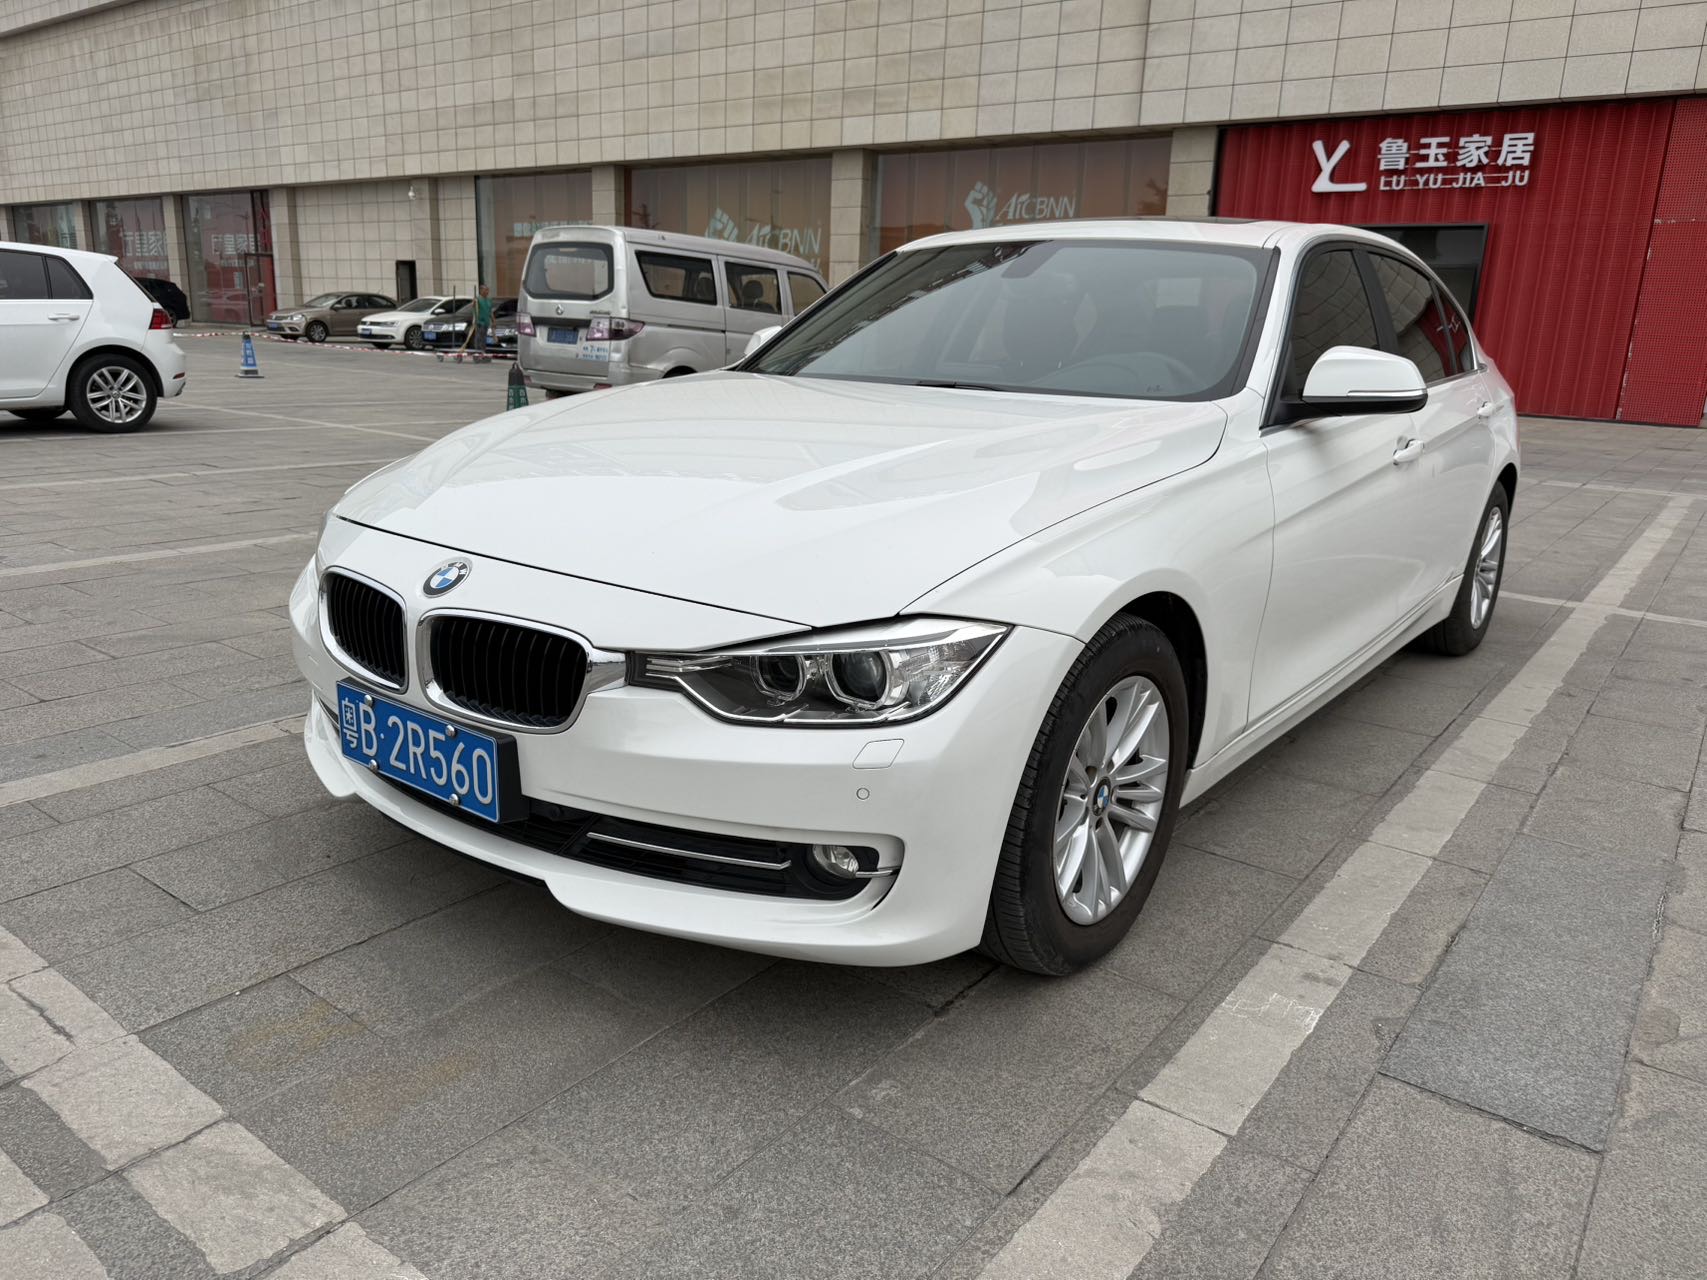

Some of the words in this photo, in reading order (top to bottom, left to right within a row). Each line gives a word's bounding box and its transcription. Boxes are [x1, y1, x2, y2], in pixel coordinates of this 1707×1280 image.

[1378, 133, 1535, 171] 鲁玉家居
[1379, 175, 1405, 191] LU
[1416, 173, 1442, 189] YU
[1452, 172, 1485, 188] JIA
[1501, 170, 1530, 186] JU
